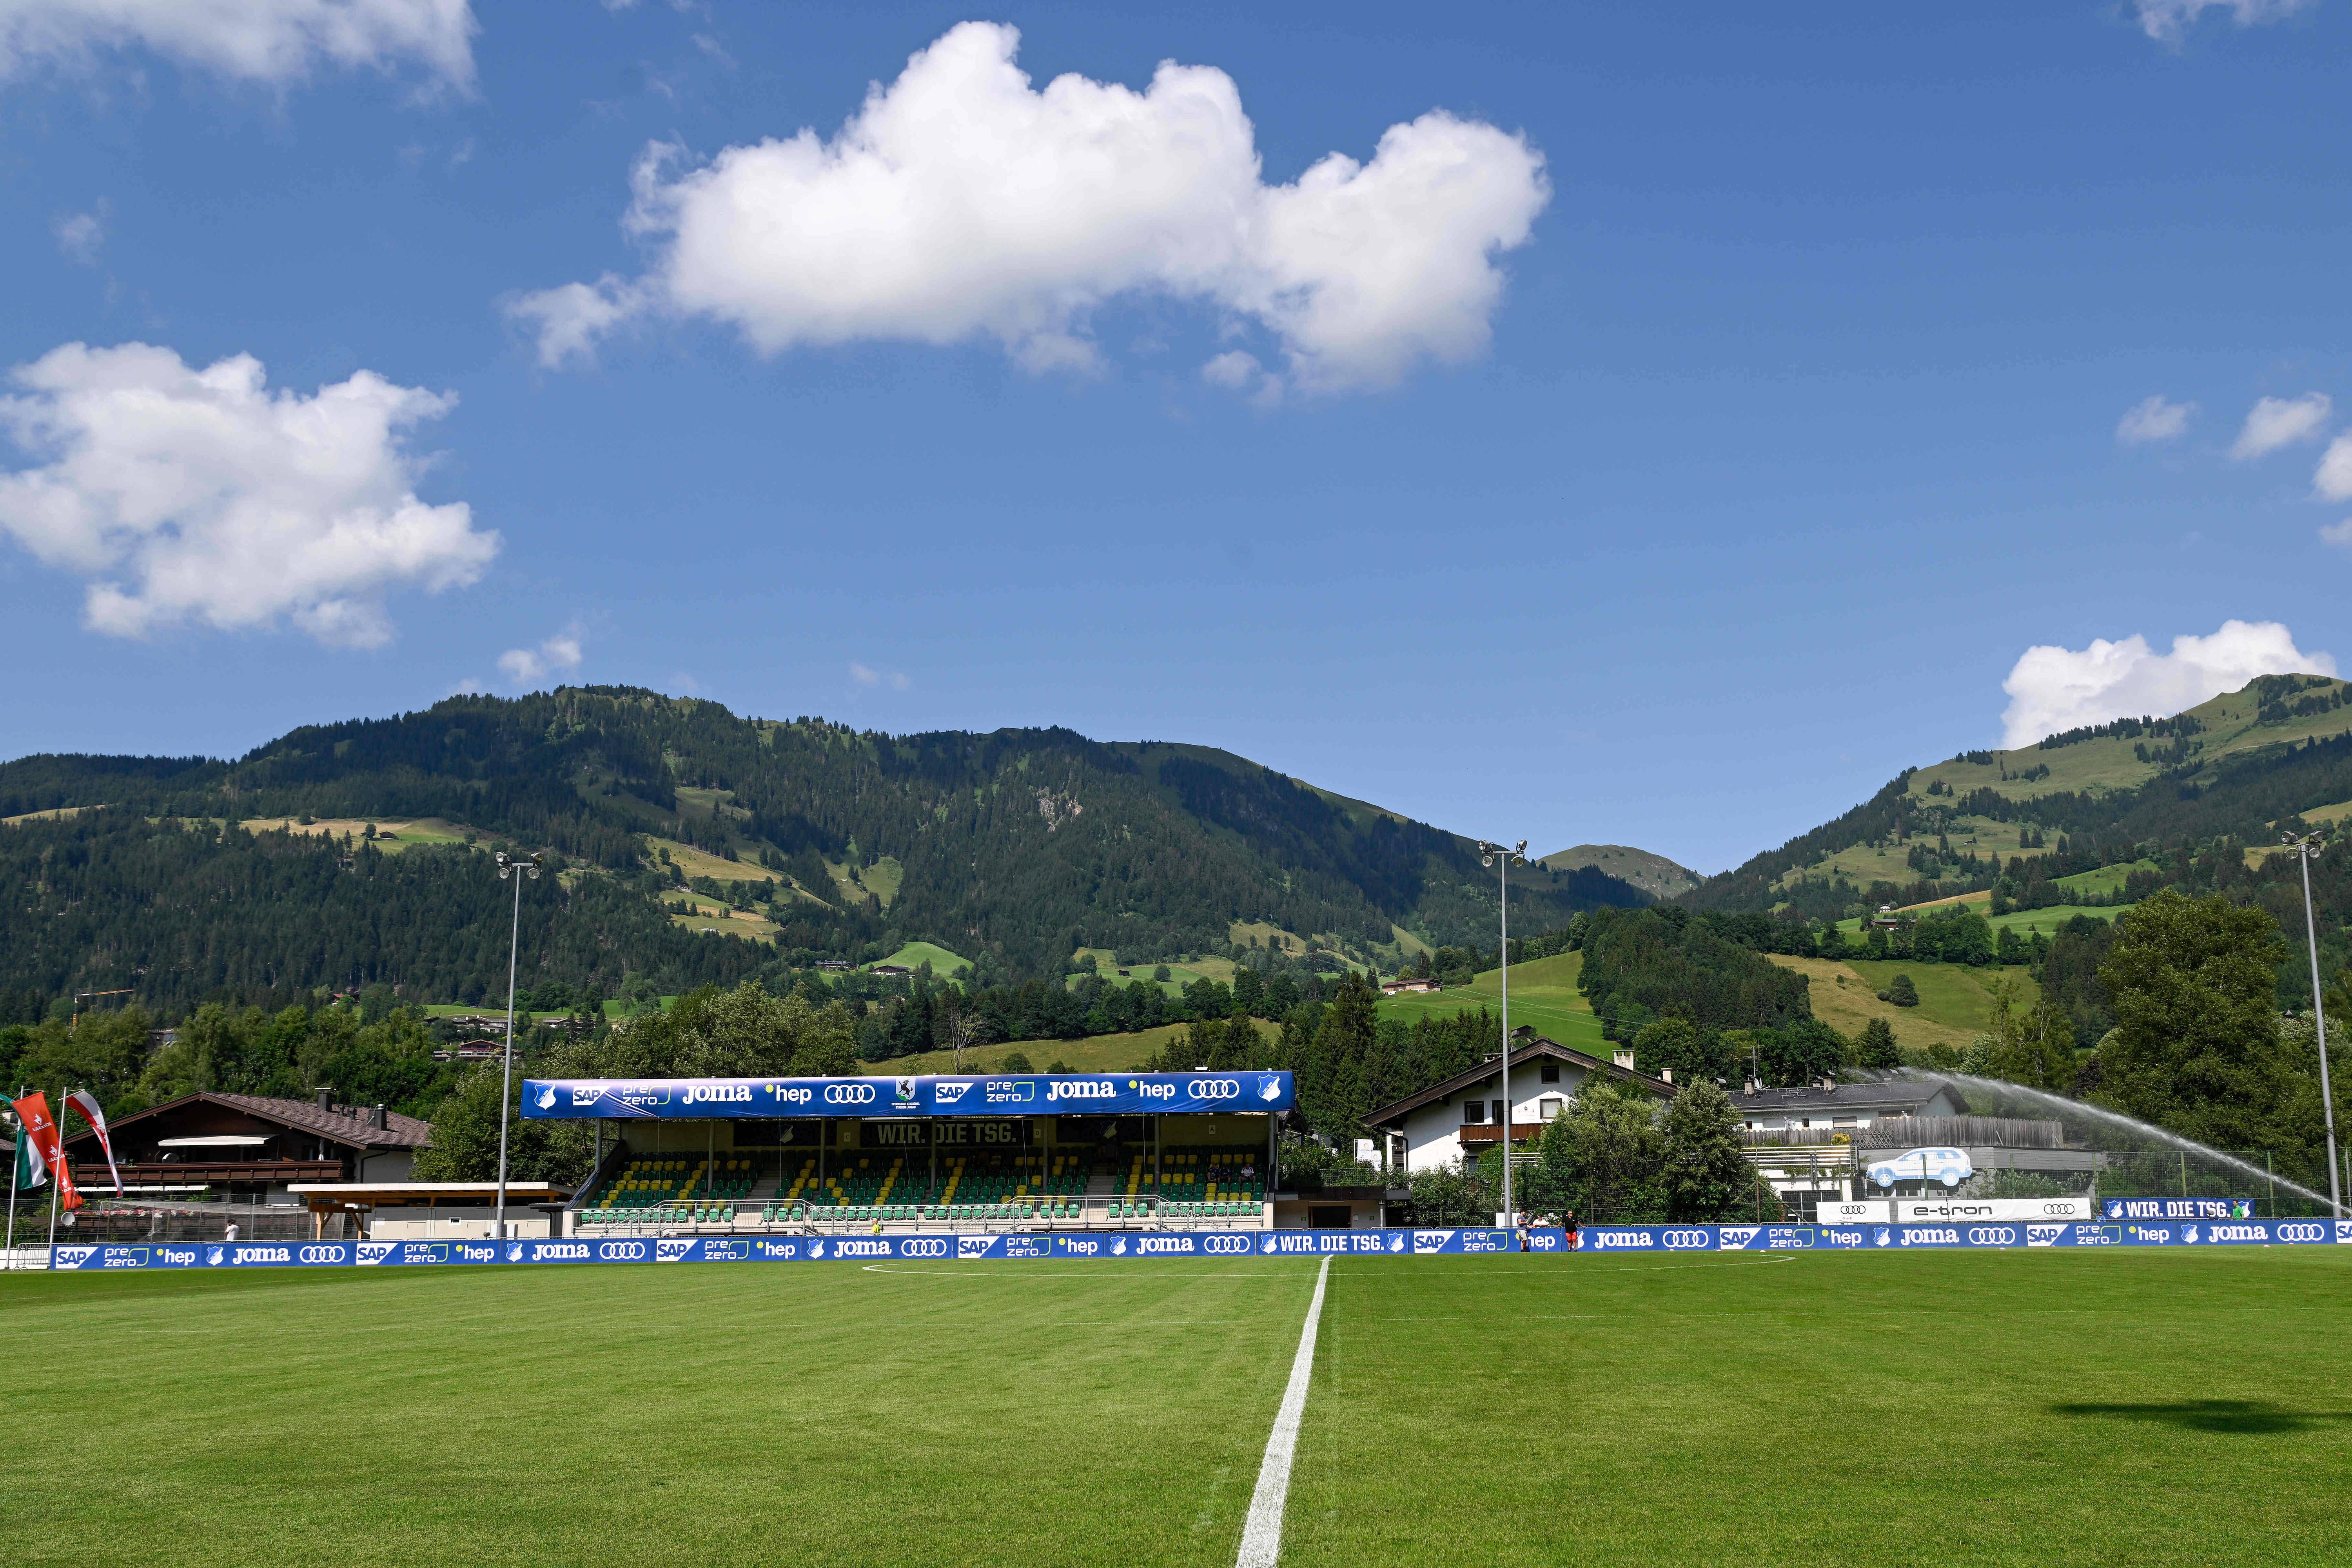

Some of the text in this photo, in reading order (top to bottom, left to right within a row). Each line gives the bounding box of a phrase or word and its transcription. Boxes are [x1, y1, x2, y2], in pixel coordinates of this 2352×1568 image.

[622, 1085, 649, 1096] pre
[937, 1087, 964, 1099] SAP
[987, 1082, 1011, 1092] pre
[1140, 1081, 1175, 1100] hep
[574, 1090, 600, 1101] SAP
[622, 1096, 657, 1105] zero
[777, 1085, 811, 1104] hep
[878, 1125, 924, 1143] WIR.
[973, 1123, 1015, 1142] TSG.
[1914, 1206, 1993, 1216] e-tron
[2126, 1202, 2163, 1217] WIR.
[2167, 1201, 2194, 1216] DIE
[1463, 1232, 1486, 1242] pre
[1769, 1229, 1794, 1239] pre
[2028, 1229, 2058, 1242] SAP
[2076, 1226, 2101, 1237] pre
[2138, 1227, 2169, 1243] hep
[1007, 1238, 1031, 1247] pre
[1280, 1235, 1384, 1251] WIR. DIE TSG.
[1416, 1236, 1445, 1249] SAP
[1721, 1232, 1750, 1245] SAP
[1770, 1238, 1802, 1247] zero
[1831, 1230, 1862, 1248] hep
[405, 1245, 429, 1256] pre
[658, 1244, 687, 1257] SAP
[705, 1241, 728, 1252] pre
[766, 1242, 795, 1259] hep
[960, 1241, 988, 1254] SAP
[1007, 1247, 1038, 1256] zero
[1068, 1238, 1098, 1255] hep
[1464, 1241, 1495, 1250] zero
[57, 1251, 86, 1264] SAP
[105, 1249, 129, 1258] pre
[165, 1249, 195, 1265] hep
[358, 1247, 387, 1260] SAP
[465, 1245, 494, 1262] hep
